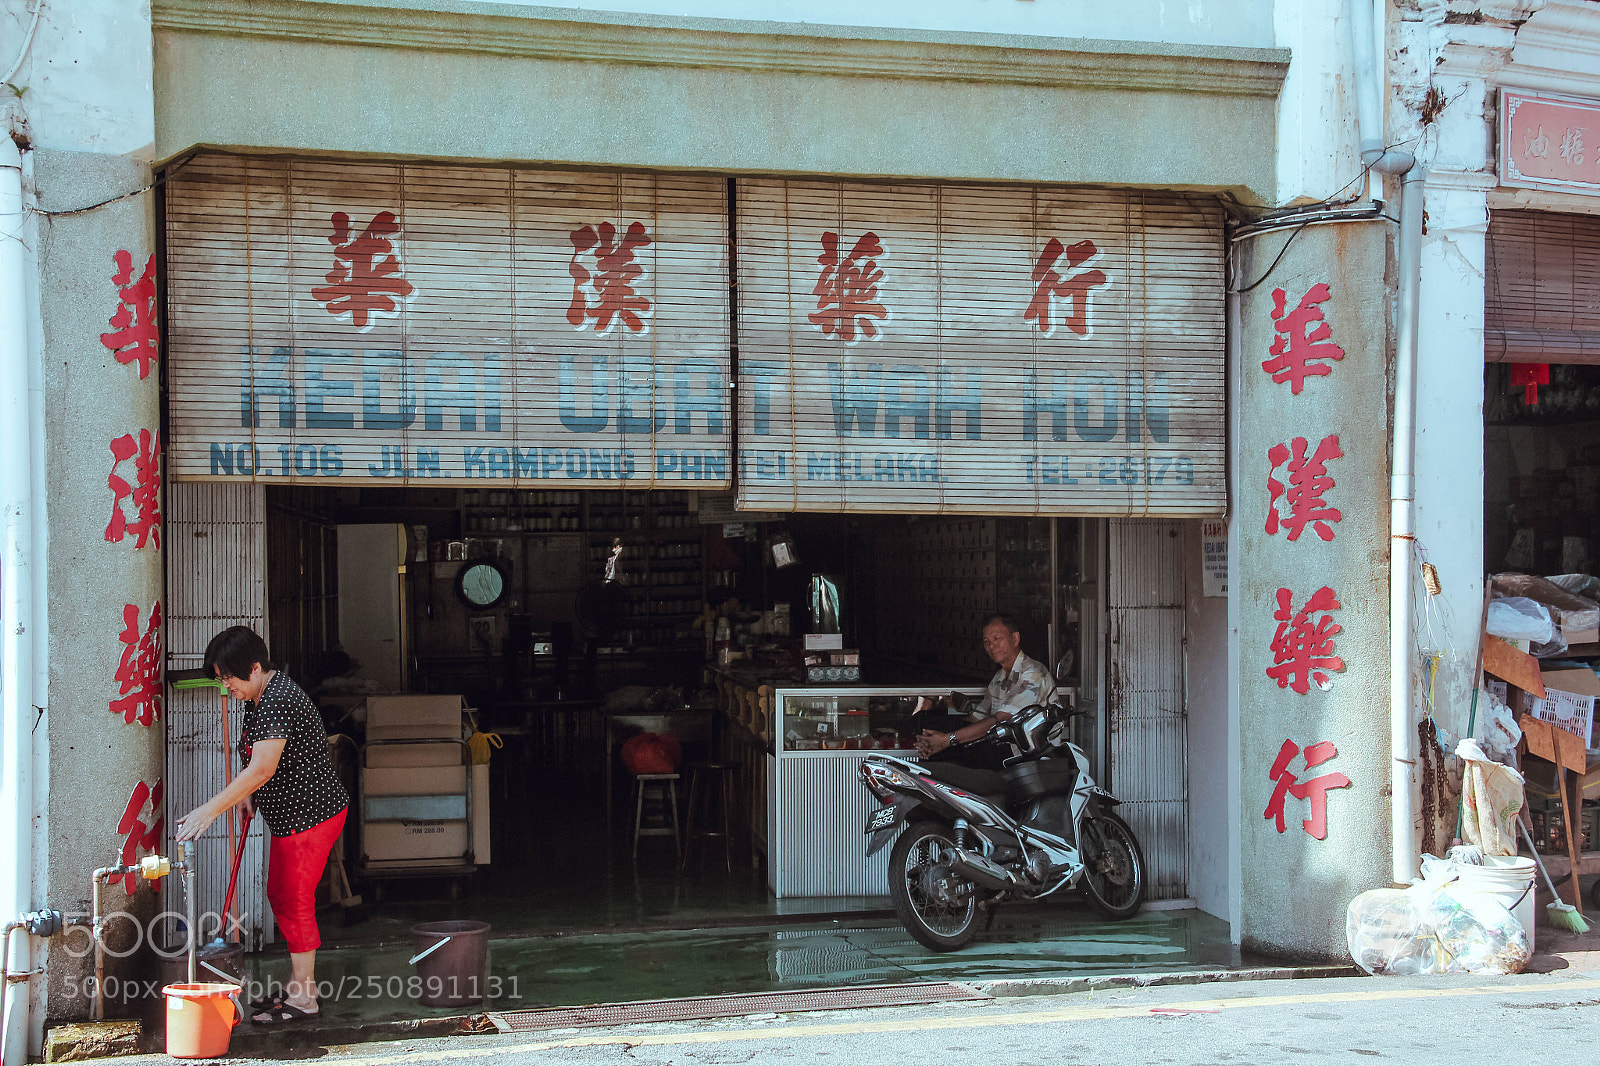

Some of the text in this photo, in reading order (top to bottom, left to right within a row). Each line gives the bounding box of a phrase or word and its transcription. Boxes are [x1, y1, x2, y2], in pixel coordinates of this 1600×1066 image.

[311, 211, 1111, 342] 華漢藥行
[240, 345, 1170, 444] KEDAI UBAT WAH HON
[210, 442, 344, 477] NO.106
[368, 445, 450, 478] JLN.
[464, 446, 635, 479] KAMPONG
[655, 448, 786, 481] PANTEI
[1262, 283, 1350, 840] 華漢藥行
